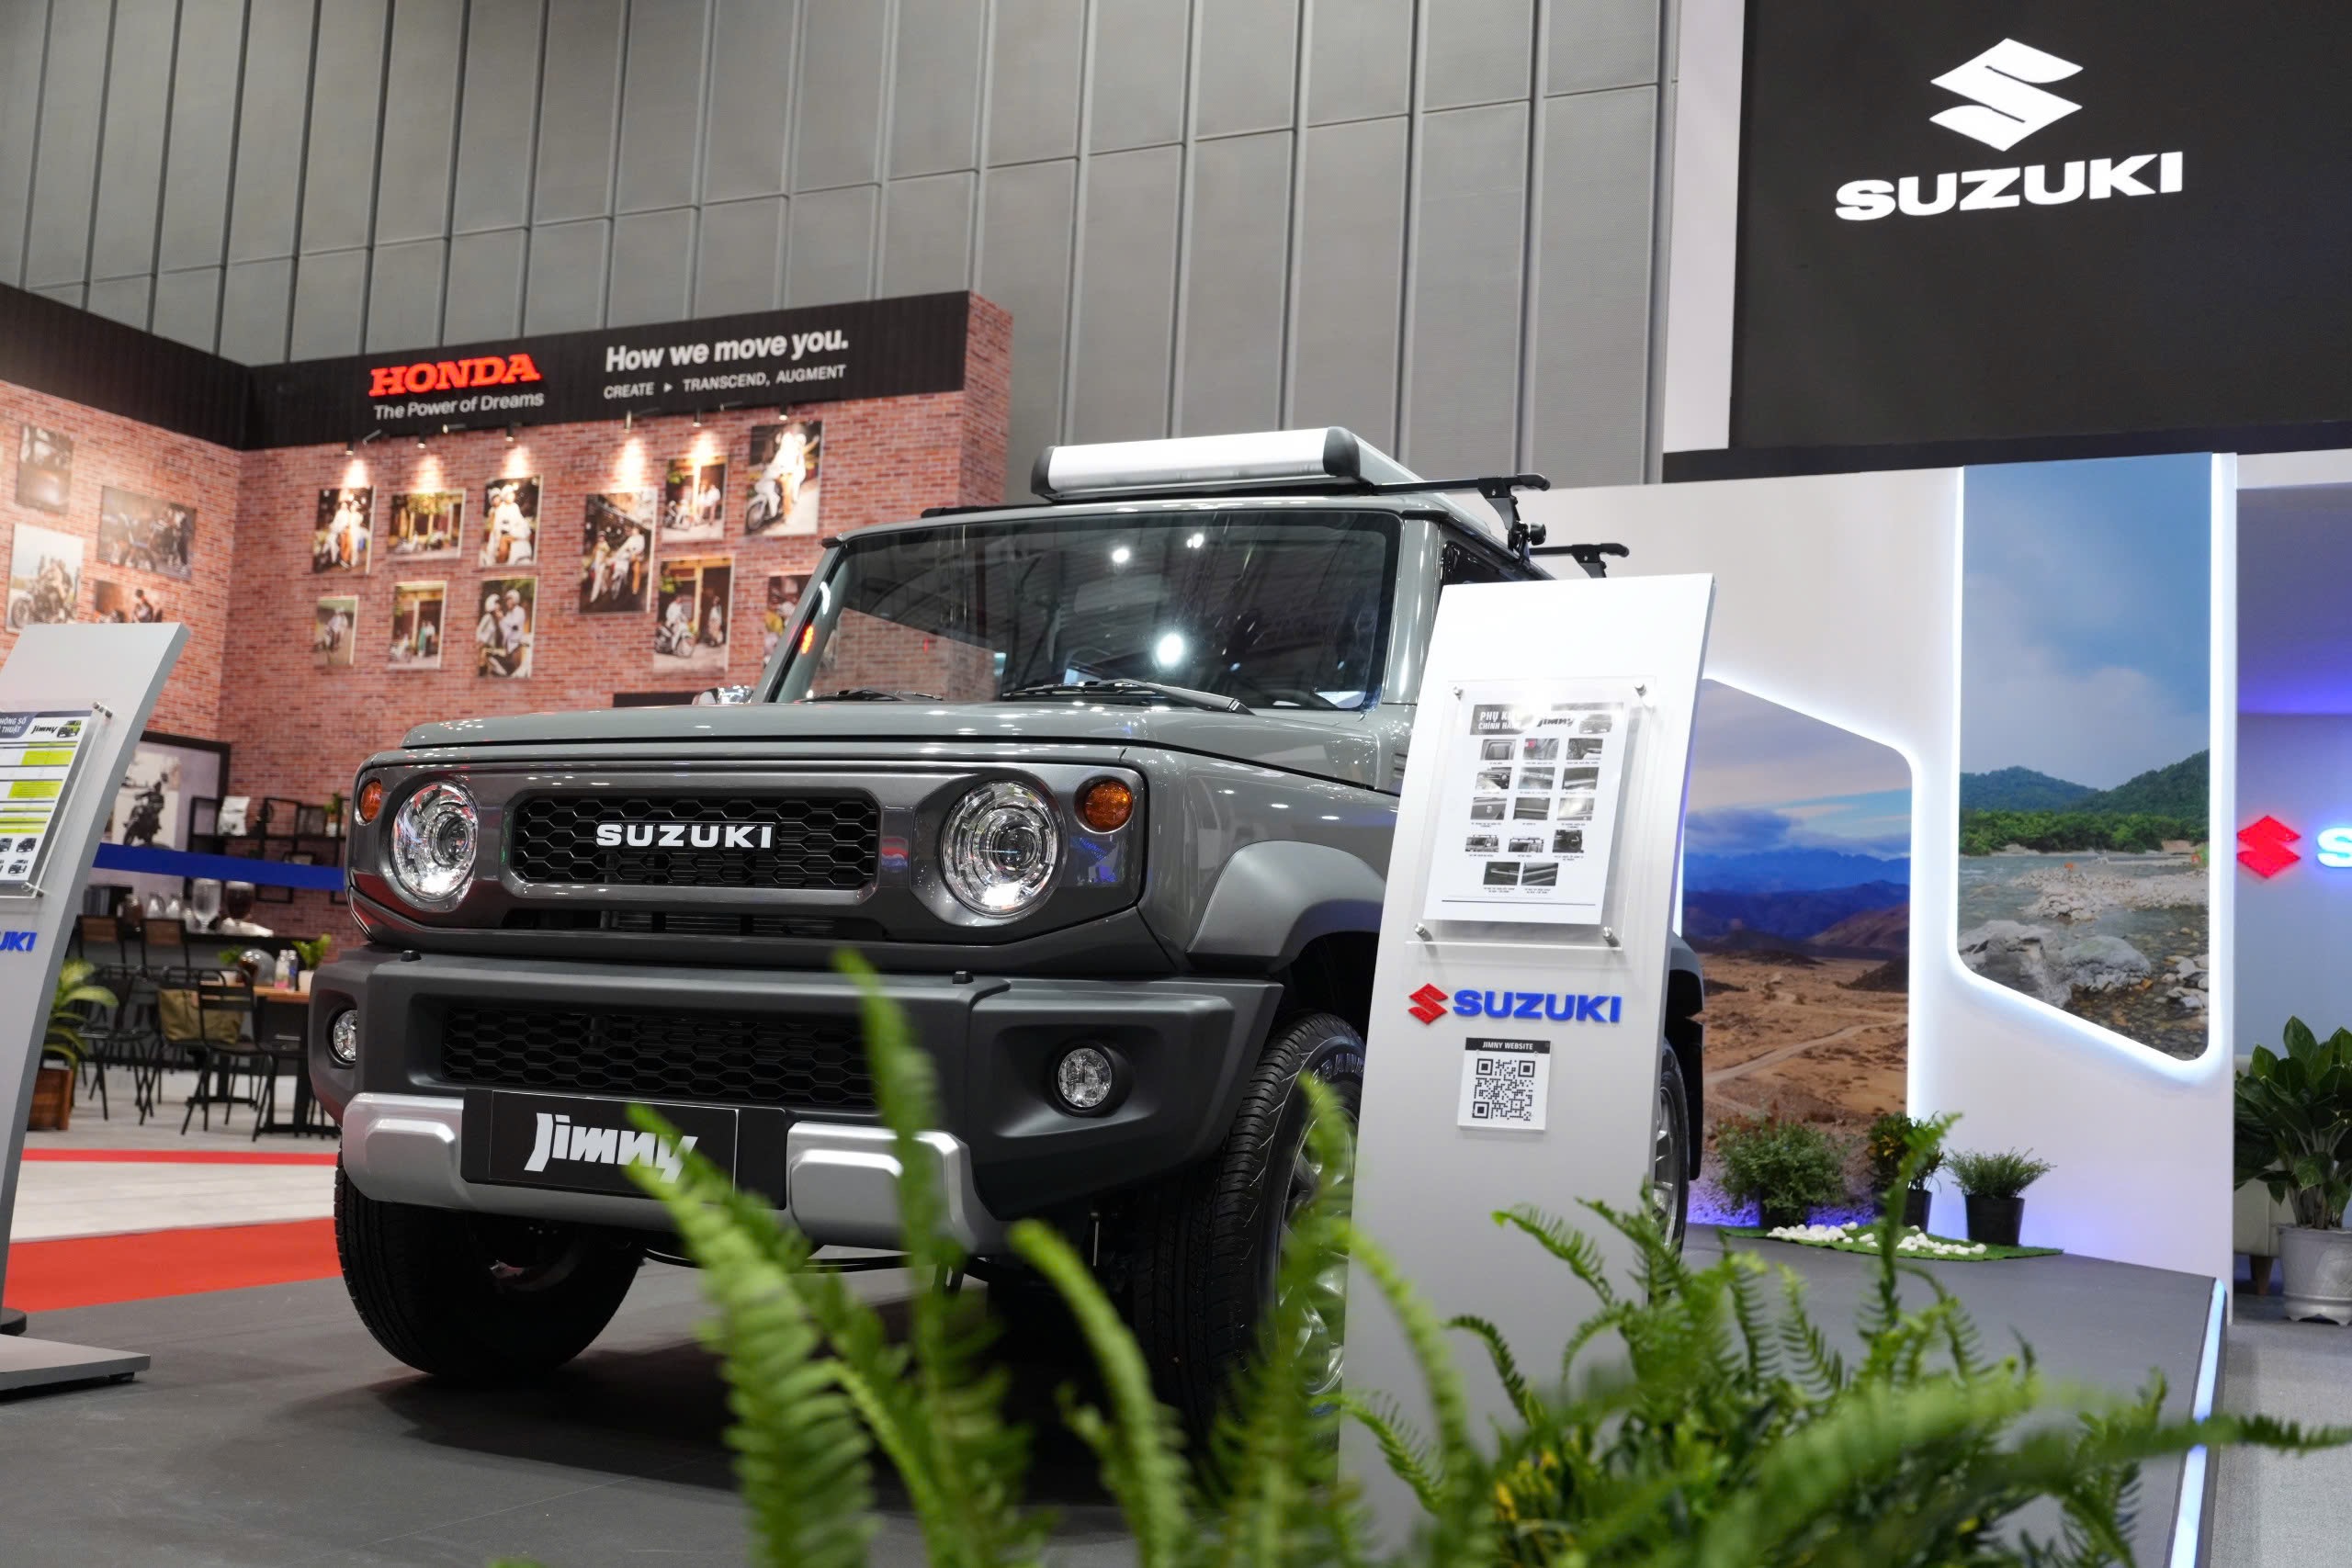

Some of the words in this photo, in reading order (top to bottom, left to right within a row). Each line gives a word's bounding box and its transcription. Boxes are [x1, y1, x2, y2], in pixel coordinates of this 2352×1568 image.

[1836, 152, 2183, 220] SUZUKI
[605, 345, 663, 372] How
[670, 344, 709, 366] we
[714, 335, 786, 363] move
[791, 330, 849, 360] you.
[368, 354, 542, 397] HONDA
[604, 382, 654, 400] CREATE
[683, 372, 771, 393] TRANSCEND,
[775, 365, 847, 384] AUGMENT
[374, 405, 404, 420] The
[408, 400, 458, 418] Power
[459, 396, 478, 412] of
[481, 393, 544, 411] Dreams
[596, 824, 772, 849] SUZUKI
[1453, 989, 1623, 1023] SUZUKI
[1482, 1041, 1503, 1049] JIMNY
[1504, 1042, 1533, 1050] WEBSITE
[524, 1112, 698, 1184] Jimny
